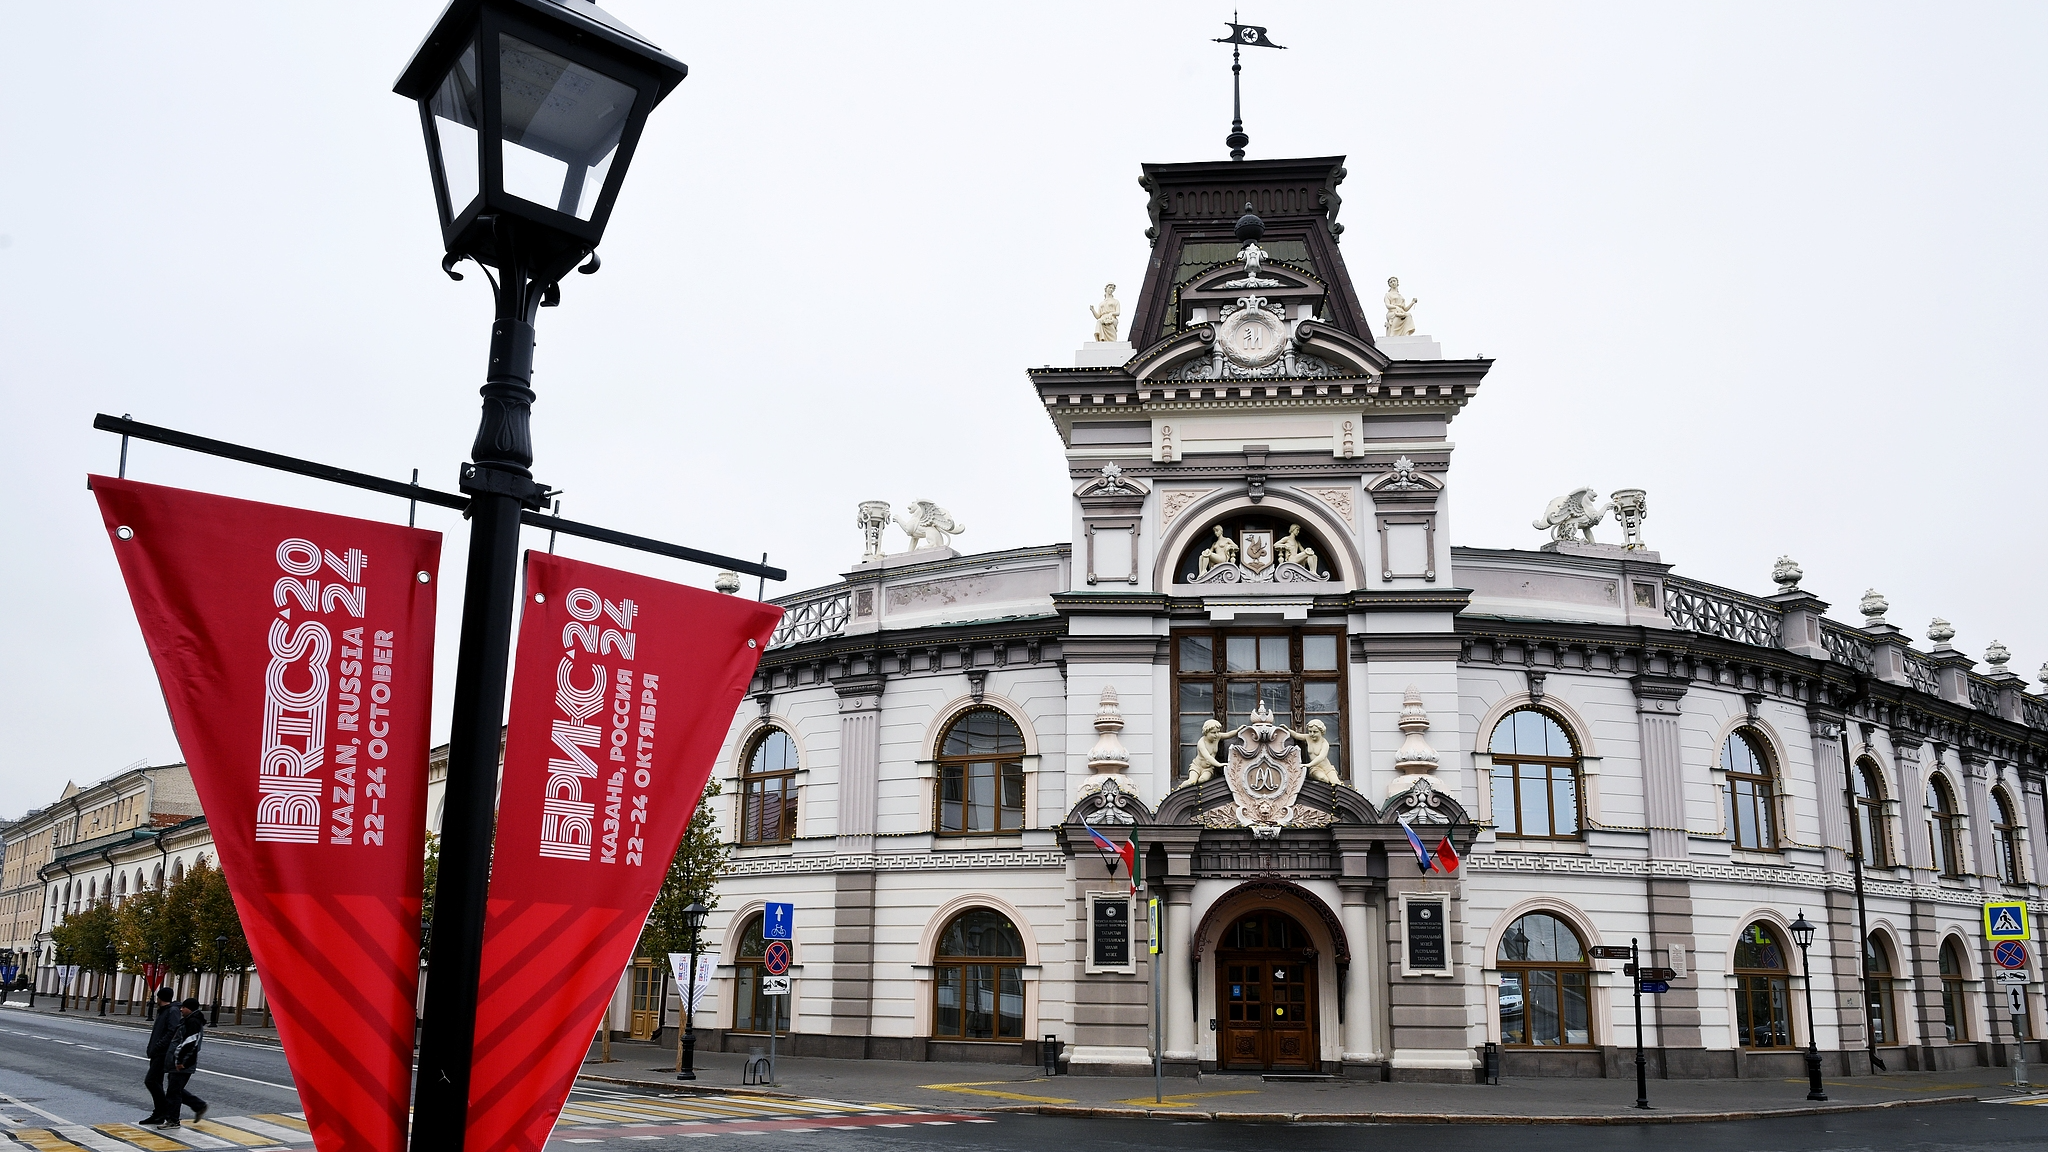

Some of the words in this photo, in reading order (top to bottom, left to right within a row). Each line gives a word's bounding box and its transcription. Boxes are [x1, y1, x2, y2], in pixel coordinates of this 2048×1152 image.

[273, 537, 323, 612] 20
[321, 547, 369, 619] 24
[562, 587, 603, 654] 20
[337, 626, 364, 732] RUSSIA
[600, 598, 639, 661] 24
[255, 617, 332, 844] BRICS
[367, 629, 394, 760] OCTOBER
[609, 668, 633, 762] РОССИЯ
[634, 673, 659, 788] ОКТЯБРЯ
[330, 738, 362, 845] KAZAN,
[538, 656, 608, 862] БРИКС
[600, 766, 627, 865] КАЗАНЬ,
